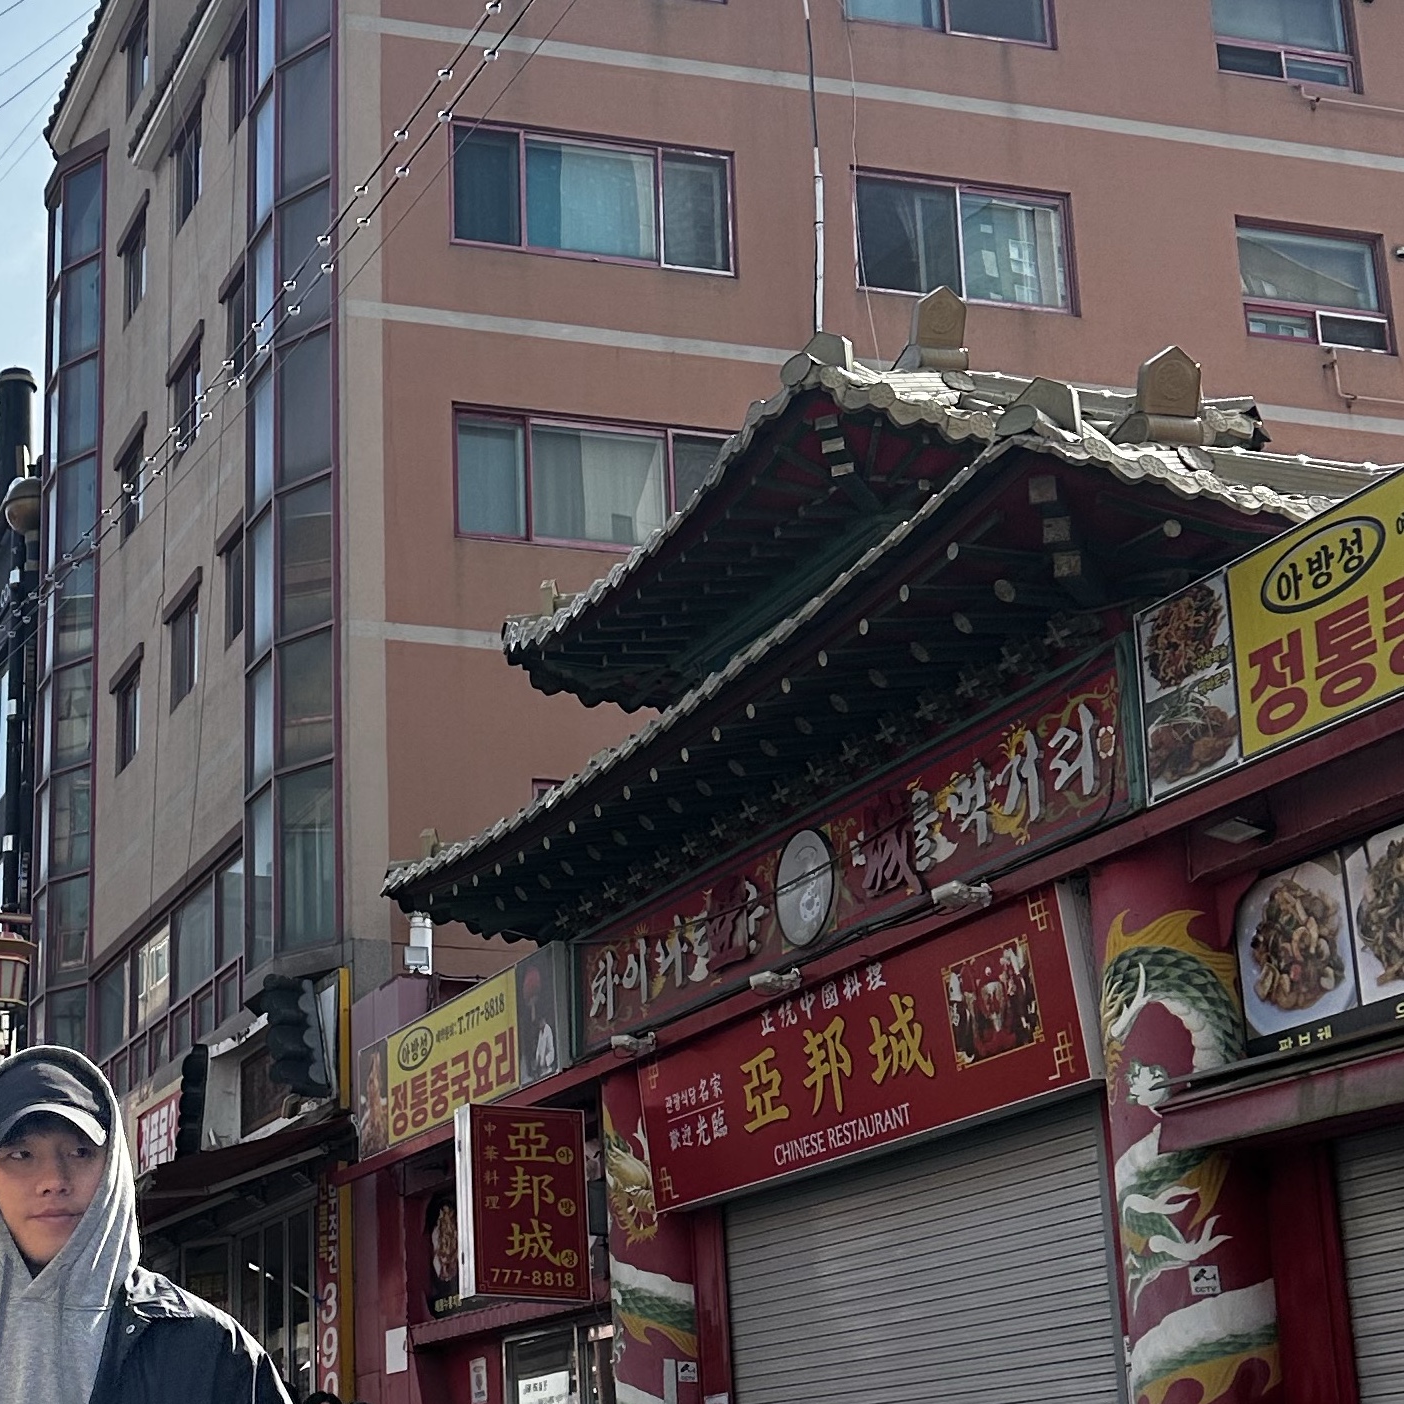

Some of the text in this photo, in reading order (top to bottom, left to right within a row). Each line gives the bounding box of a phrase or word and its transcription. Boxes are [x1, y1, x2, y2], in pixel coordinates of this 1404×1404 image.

[1277, 528, 1365, 603] 아방성
[390, 1027, 517, 1137] 정통중국요리
[401, 1031, 428, 1065] 아방성
[739, 992, 936, 1134] 亞邦城
[773, 1102, 911, 1166] CHINESE RESTAURANT
[503, 1121, 562, 1267] 亞邦城
[490, 1267, 576, 1288] 777-8818
[1194, 1285, 1218, 1293] CCTV
